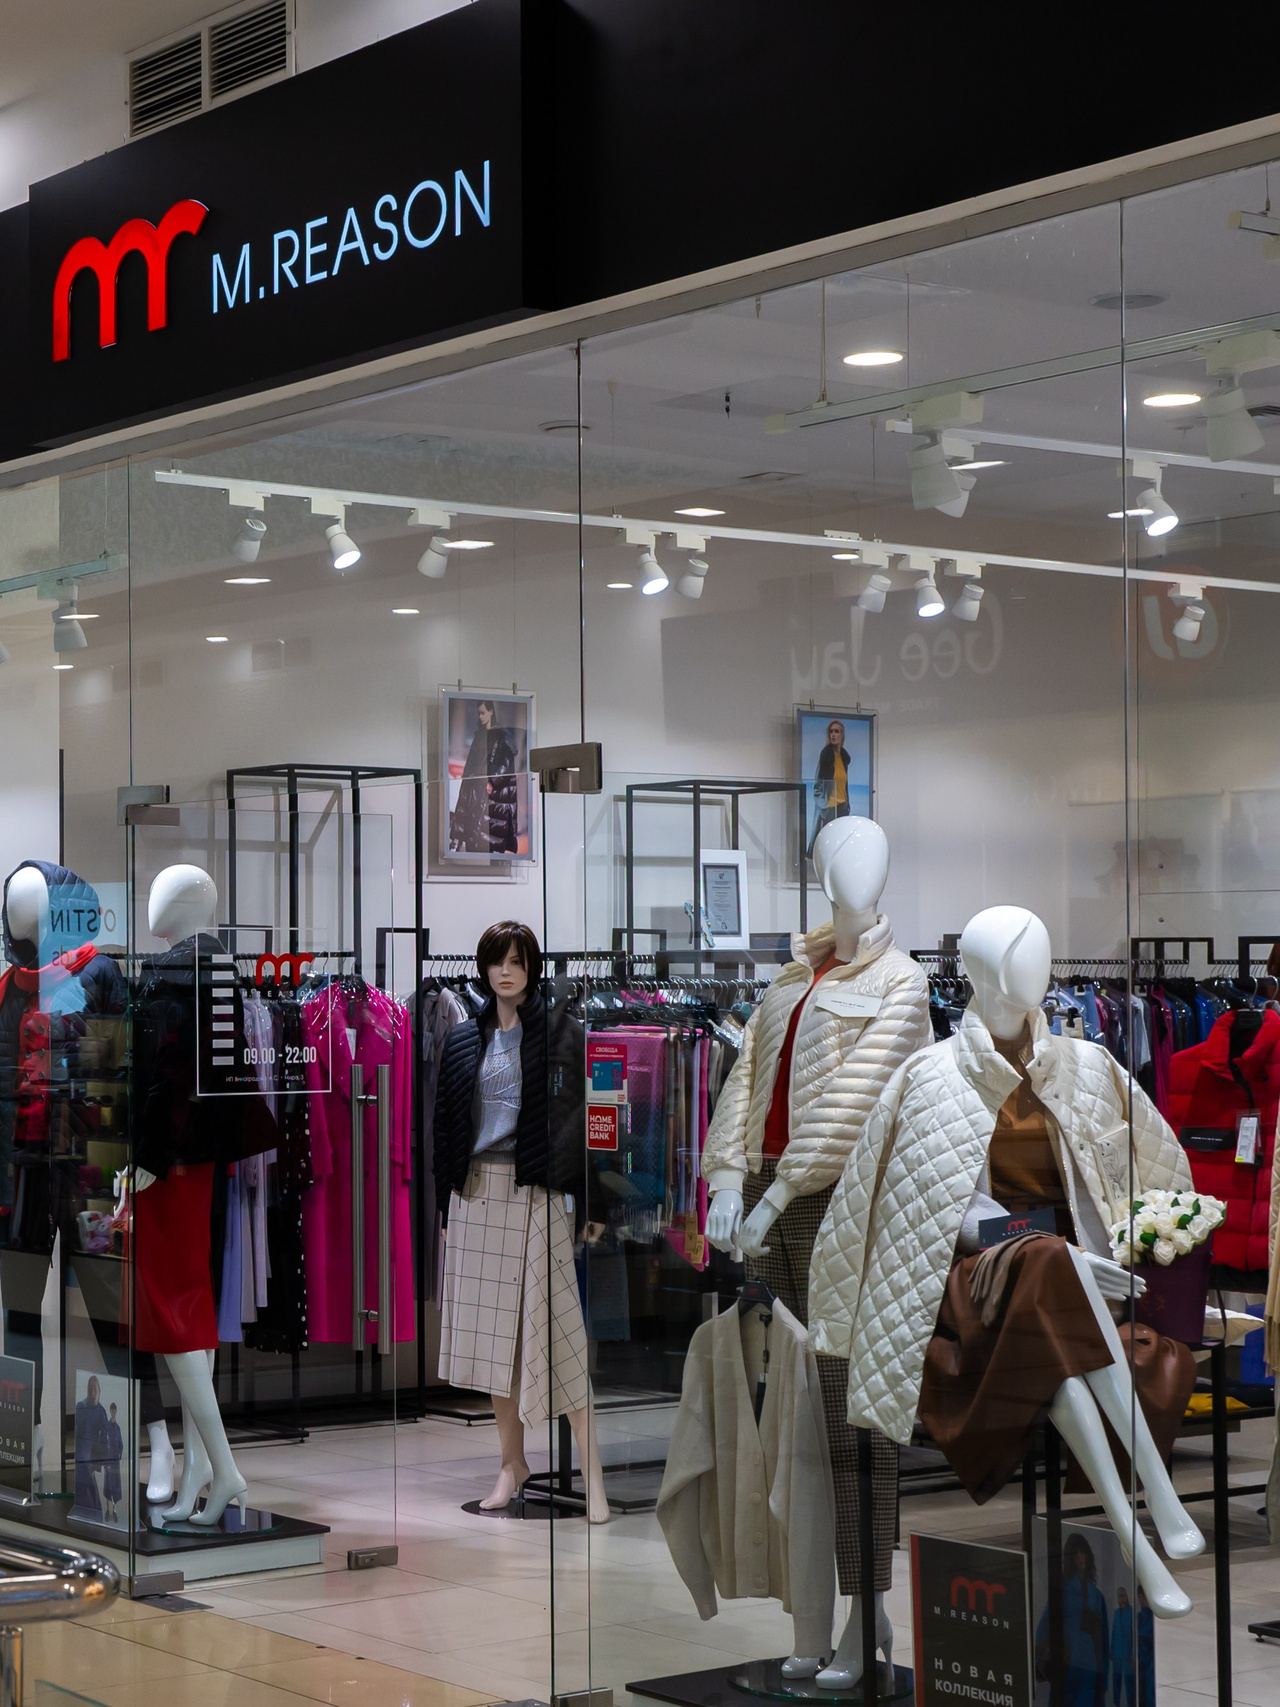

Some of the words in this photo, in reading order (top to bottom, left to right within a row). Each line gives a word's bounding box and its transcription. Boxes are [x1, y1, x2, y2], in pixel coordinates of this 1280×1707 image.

[212, 160, 490, 313] M.REASON
[243, 1047, 276, 1065] 09.00
[285, 1046, 317, 1064] 22.00
[589, 1115, 613, 1124] HOME
[589, 1123, 615, 1132] CREDIT
[589, 1131, 610, 1140] BANK
[933, 1605, 1010, 1630] M.REASON
[934, 1657, 1013, 1687] НОВАЯ
[934, 1678, 1014, 1707] КОЛЛЕКЦИЯ
